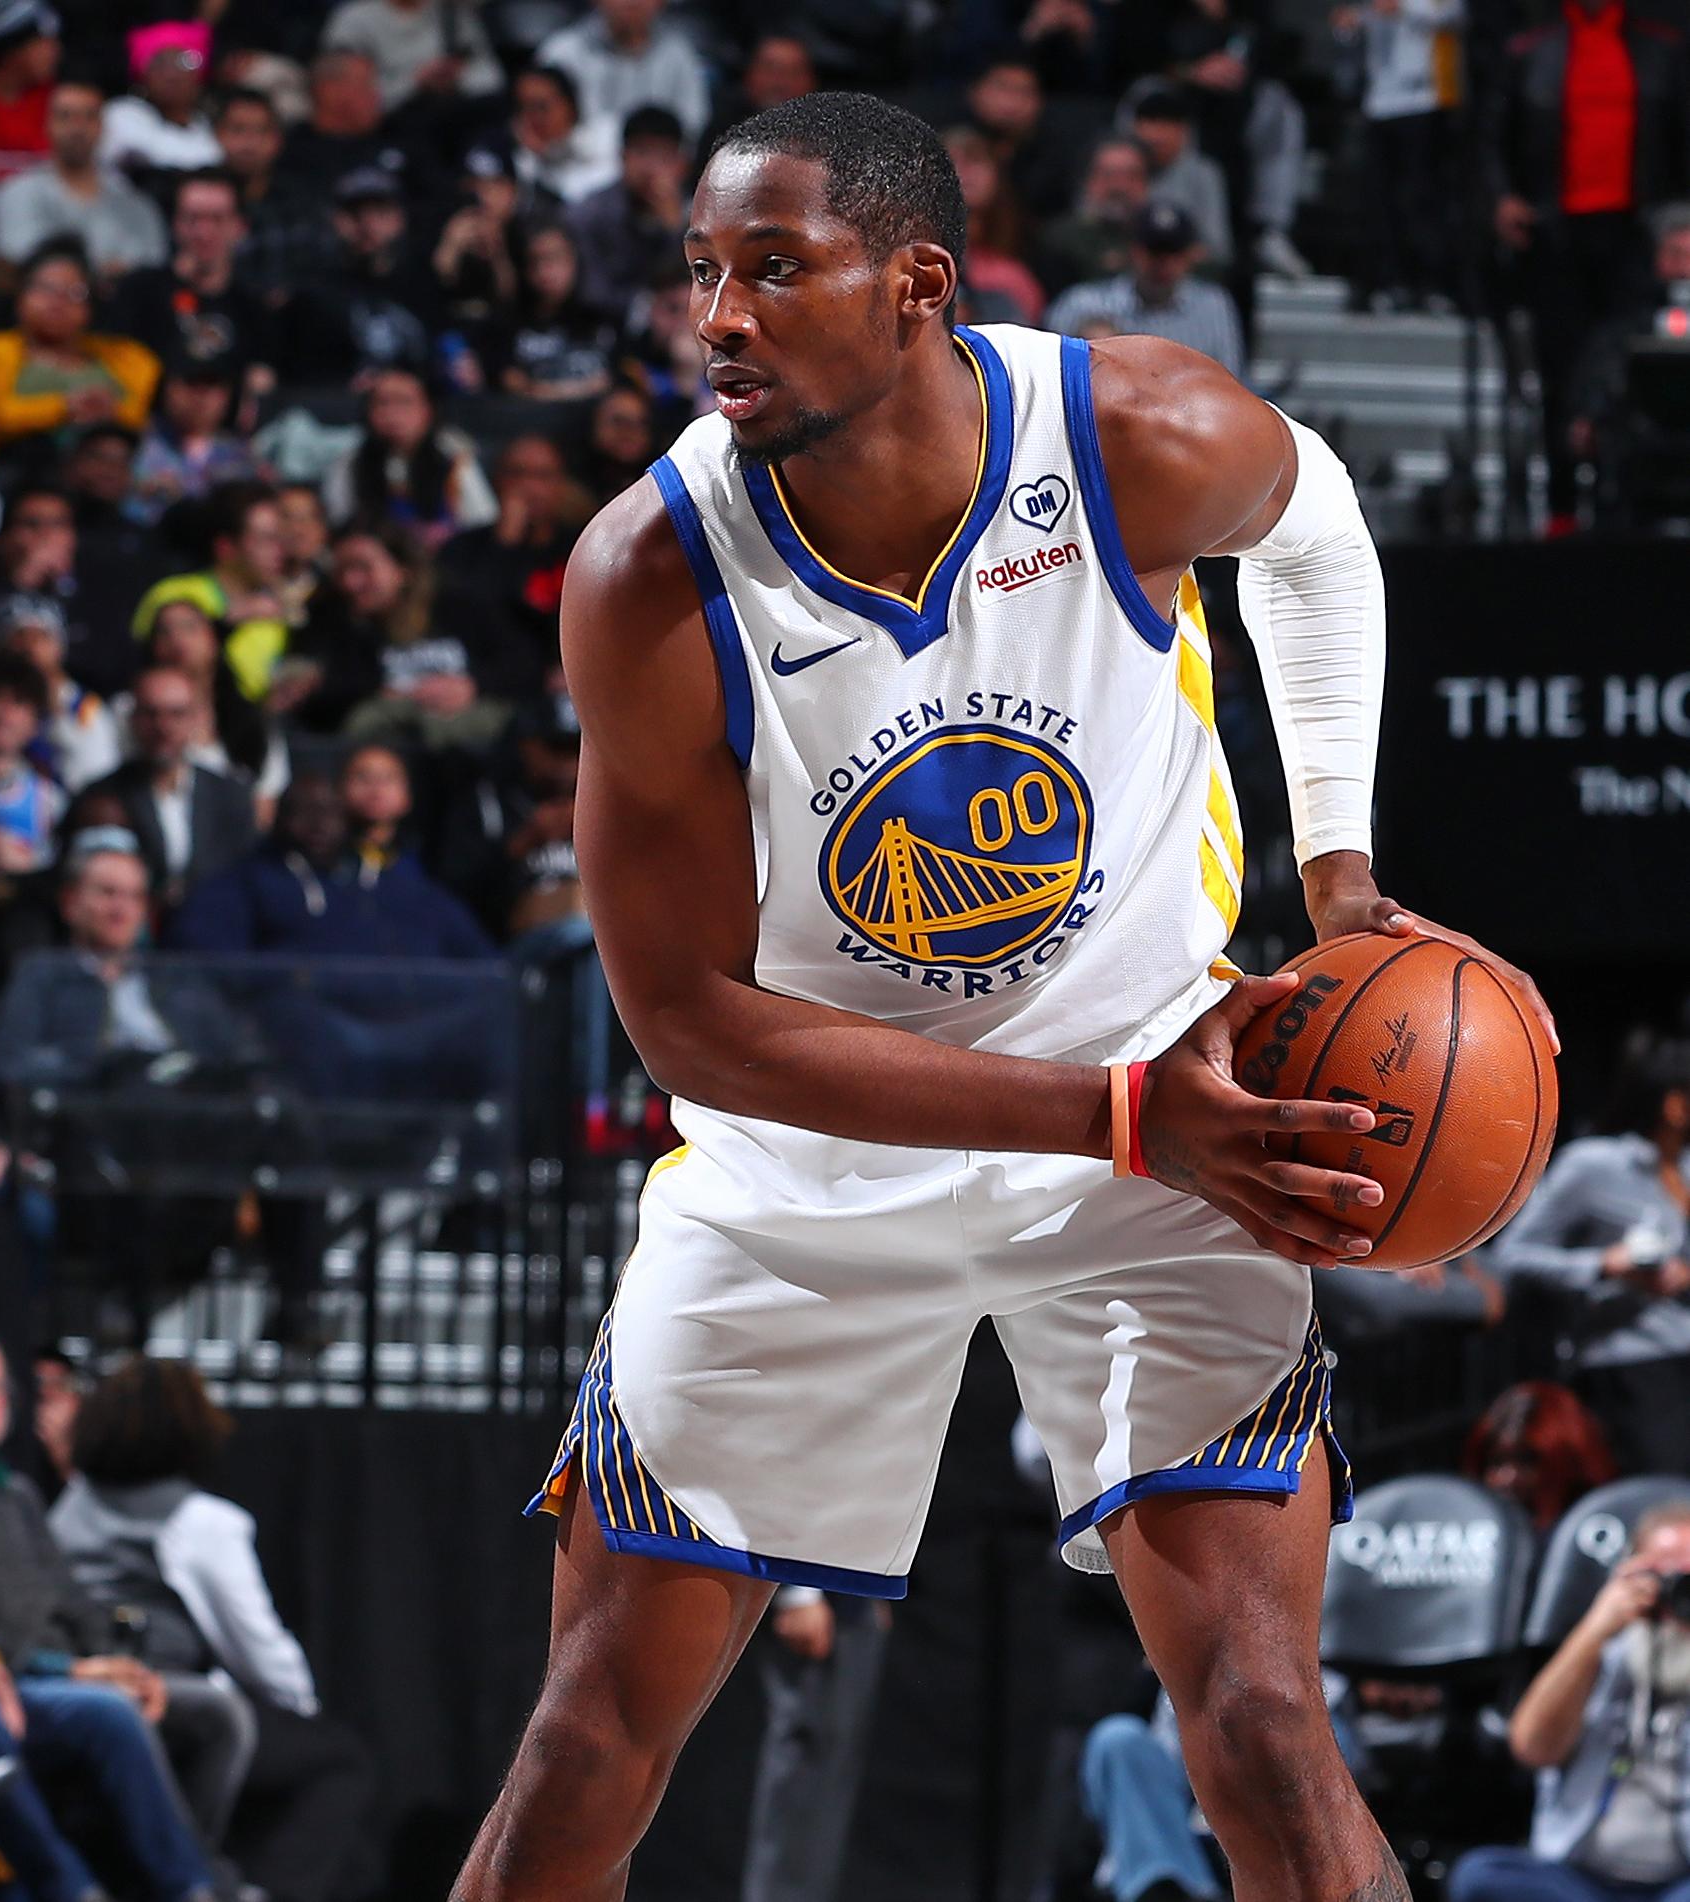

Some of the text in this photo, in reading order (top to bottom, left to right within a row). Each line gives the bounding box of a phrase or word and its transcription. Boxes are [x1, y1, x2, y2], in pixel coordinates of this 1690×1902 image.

[1025, 489, 1058, 518] DM
[976, 542, 1082, 593] Rakuten
[1436, 675, 1585, 739] THE
[810, 691, 1079, 816] GOLDEN STATE
[968, 771, 1059, 852] 00
[1575, 766, 1659, 815] The
[834, 868, 1106, 999] WARRIORS
[1339, 1519, 1499, 1570] QATAR
